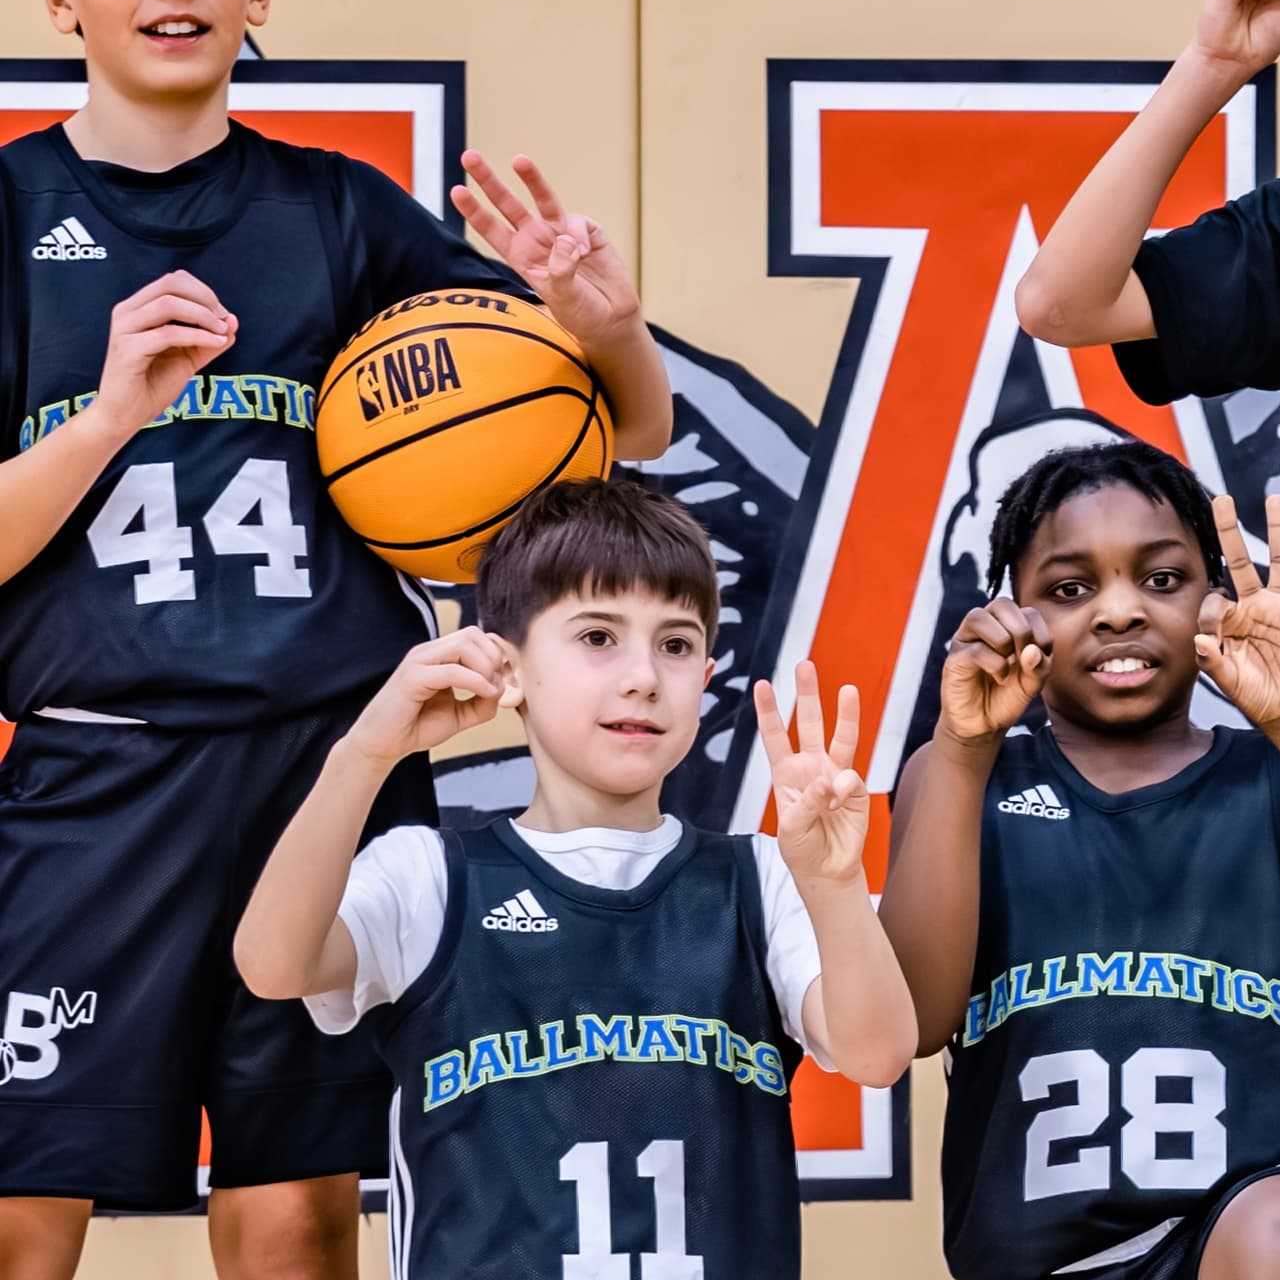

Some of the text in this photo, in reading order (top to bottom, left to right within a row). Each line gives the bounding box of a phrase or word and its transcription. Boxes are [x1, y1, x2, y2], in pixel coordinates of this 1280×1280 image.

[32, 242, 107, 261] adidas
[383, 337, 462, 409] NBA
[19, 374, 315, 453] BAMATI
[87, 459, 312, 605] 44
[997, 798, 1070, 820] adidas
[482, 912, 559, 933] adidas
[424, 1013, 787, 1113] BALLMATICS
[1018, 1047, 1227, 1202] 28
